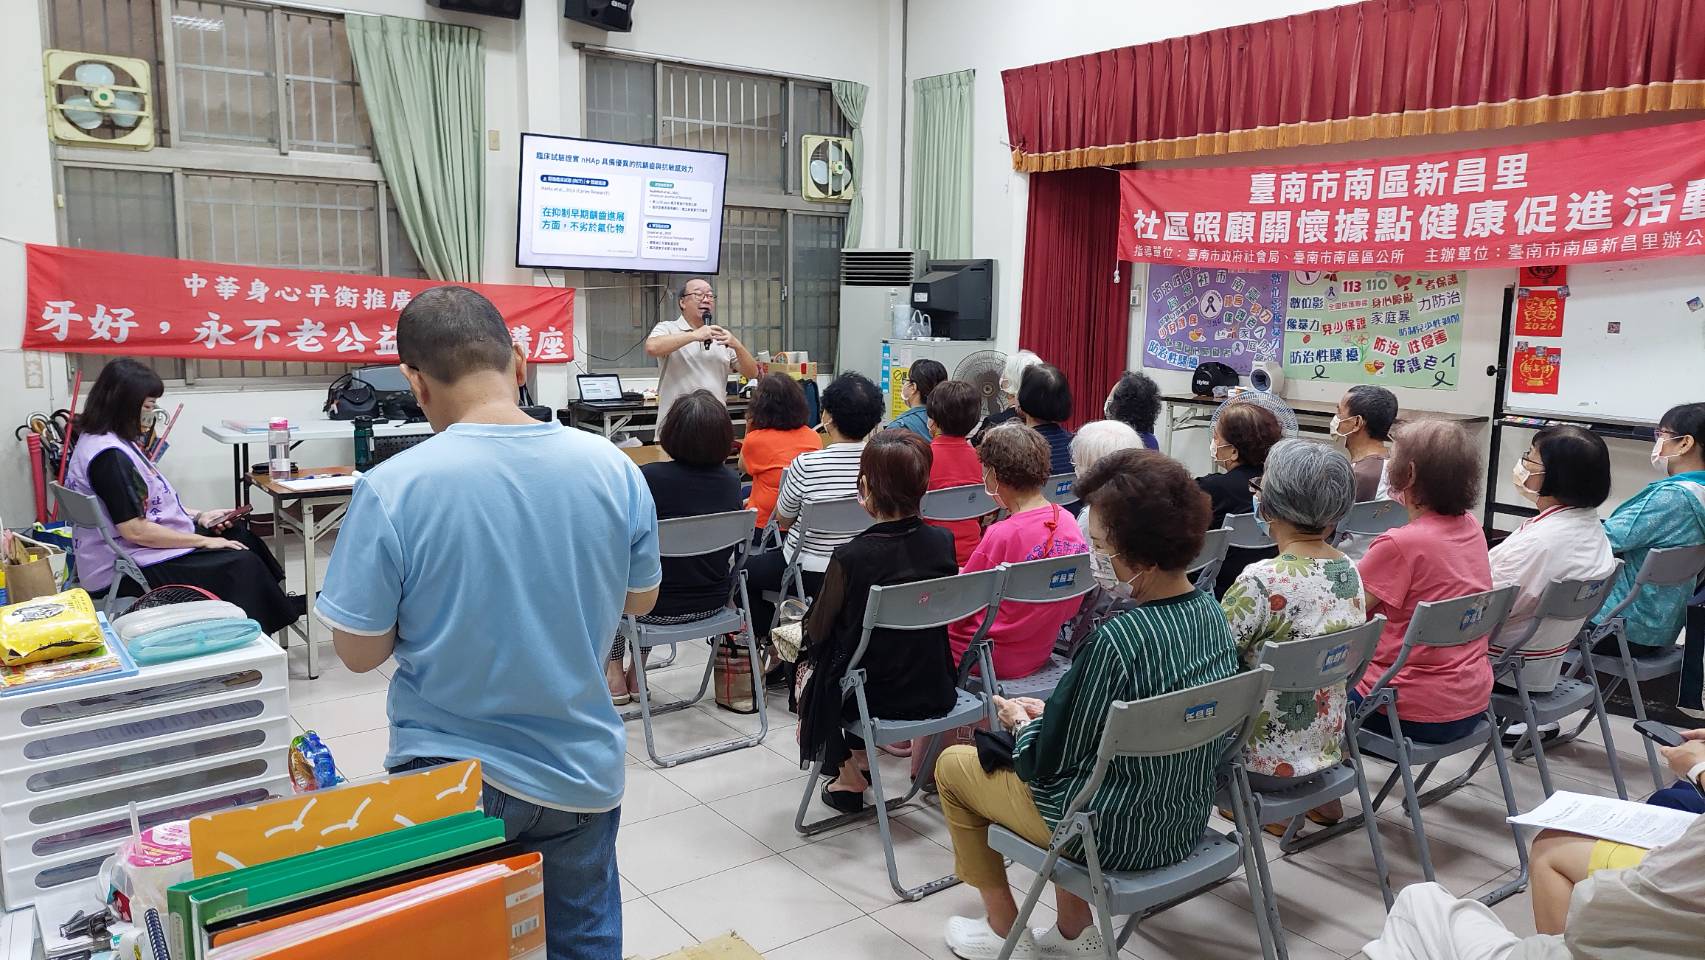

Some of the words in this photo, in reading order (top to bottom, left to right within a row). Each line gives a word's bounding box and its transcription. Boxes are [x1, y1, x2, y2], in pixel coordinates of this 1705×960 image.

[581, 157, 600, 165] nHAp
[1249, 153, 1529, 204] 臺南市南區新昌里
[542, 207, 624, 221] 在抑制早期齲齒進展
[1343, 280, 1362, 292] 113
[1366, 279, 1388, 291] 110
[183, 273, 412, 311] 中華身心平衡推廣
